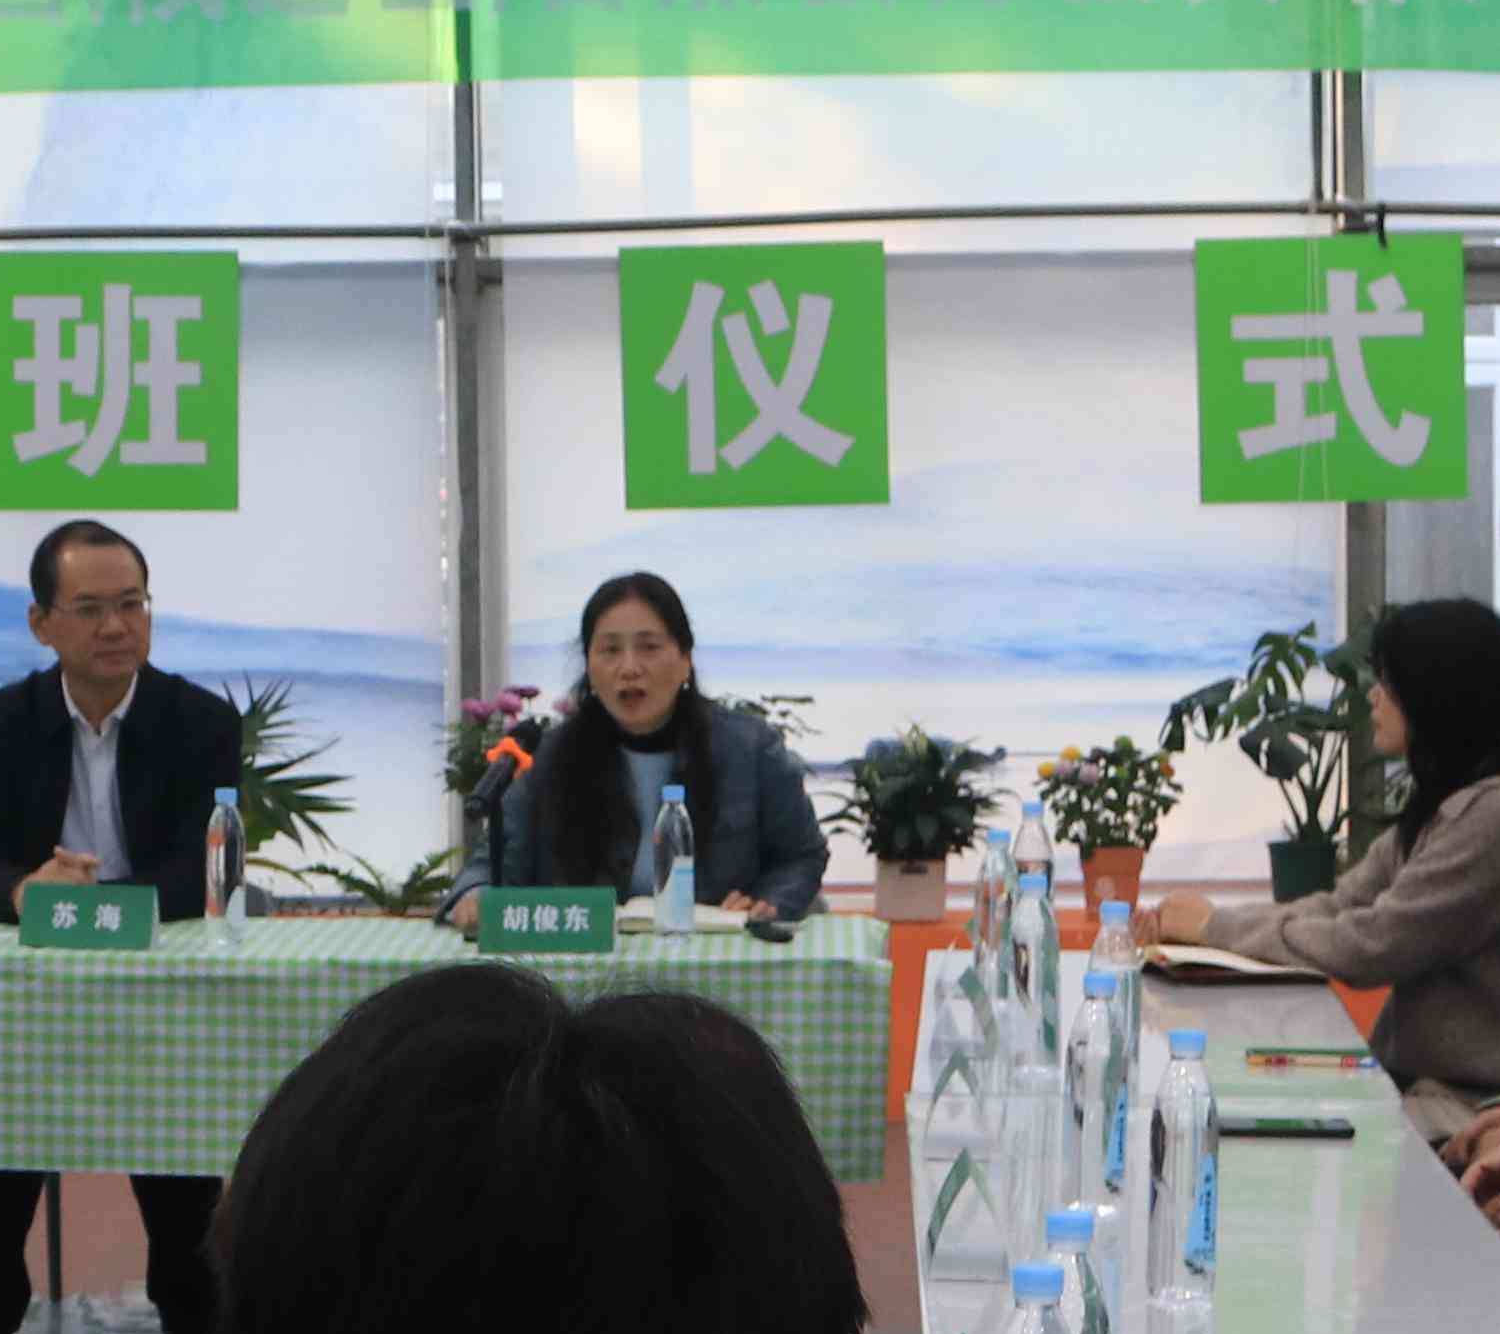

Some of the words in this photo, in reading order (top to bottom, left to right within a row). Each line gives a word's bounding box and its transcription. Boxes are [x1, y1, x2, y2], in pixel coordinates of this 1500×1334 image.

[11, 282, 208, 477] 班
[654, 280, 856, 475] 仪
[1230, 268, 1433, 468] 式
